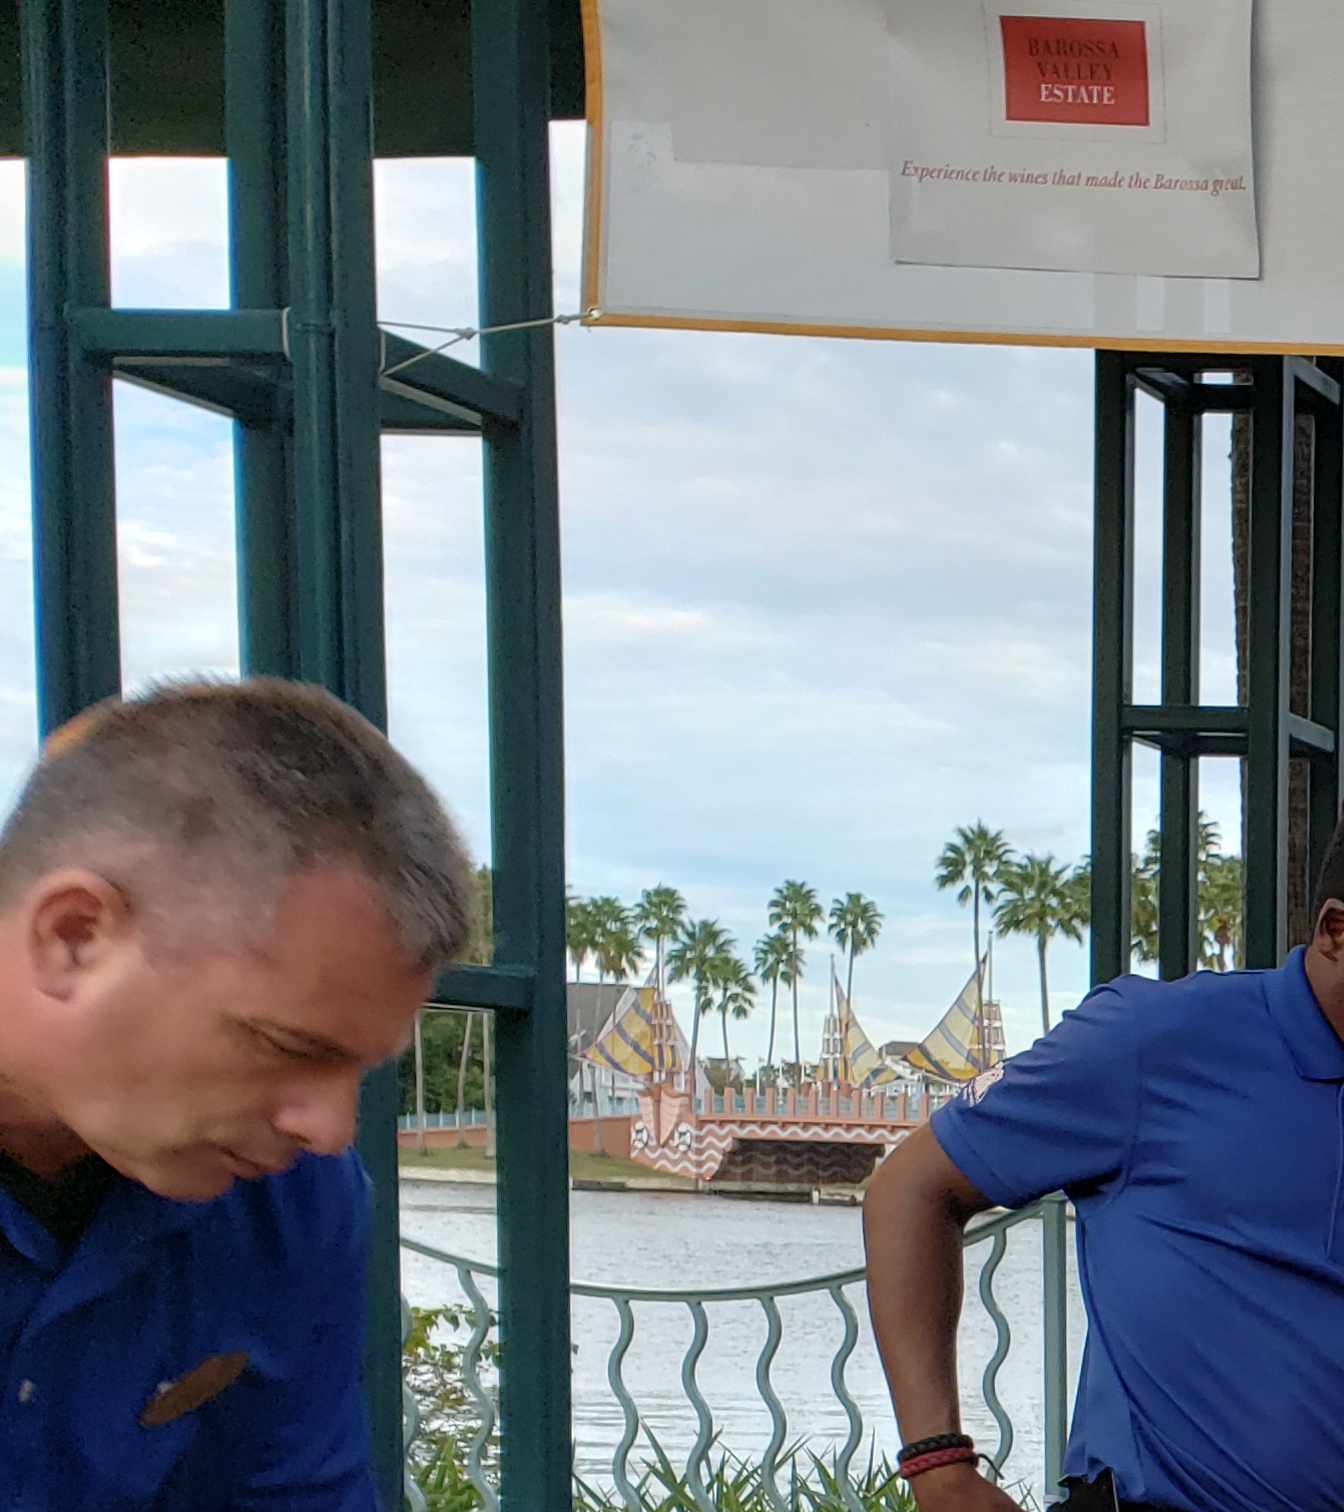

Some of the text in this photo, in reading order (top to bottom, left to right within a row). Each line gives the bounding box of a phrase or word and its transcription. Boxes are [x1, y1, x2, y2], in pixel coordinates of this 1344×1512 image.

[1028, 38, 1121, 59] BAROSSA
[1038, 61, 1113, 80] VALLEY
[1040, 83, 1116, 105] ESTATE
[901, 160, 980, 181] Experience
[983, 165, 1005, 182] the
[1008, 167, 1048, 185] wines
[1052, 169, 1081, 187] that
[1085, 171, 1125, 189] made
[1128, 172, 1151, 190] the
[1153, 173, 1209, 192] Barossa
